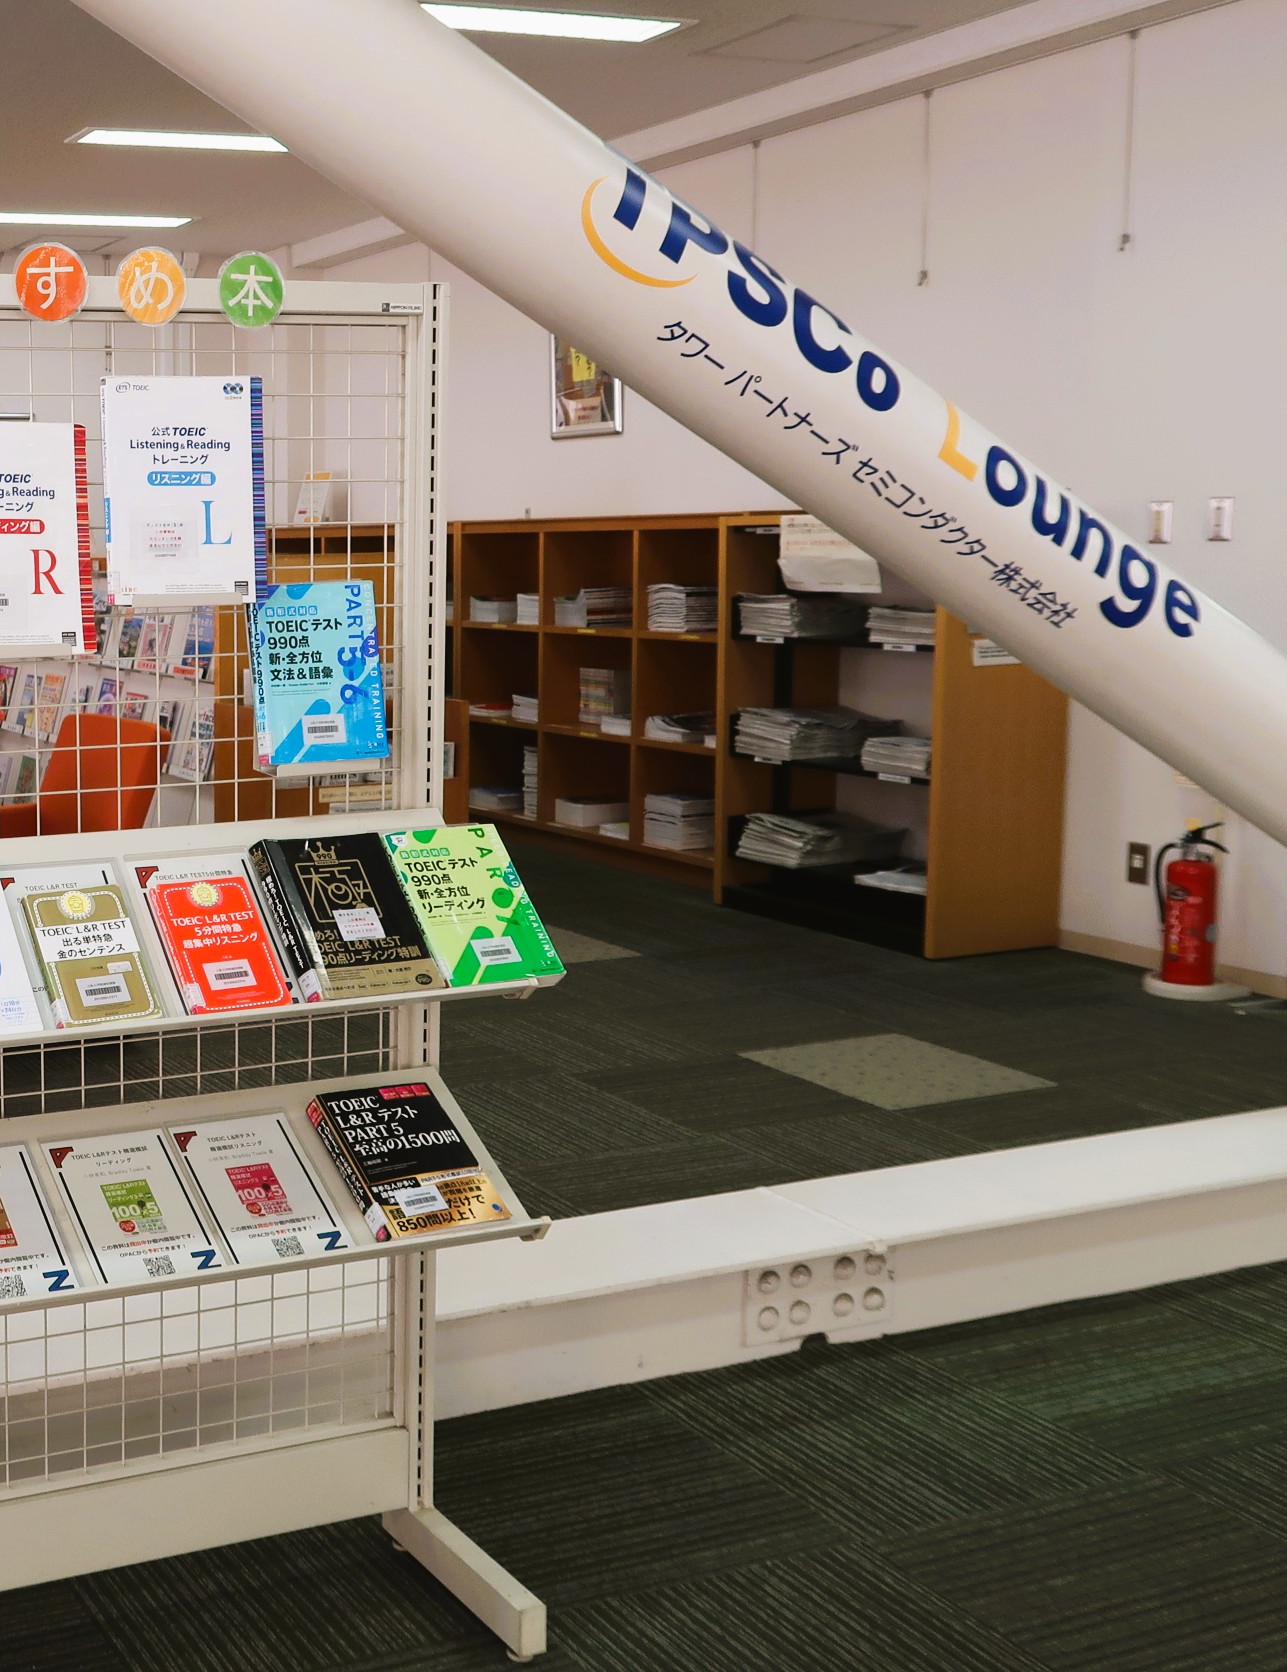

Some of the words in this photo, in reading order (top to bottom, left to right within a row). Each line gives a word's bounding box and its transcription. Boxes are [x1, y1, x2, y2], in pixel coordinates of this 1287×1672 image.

[151, 427, 170, 436] 公式
[172, 427, 206, 436] TOEIC
[130, 439, 179, 451] Listening
[187, 439, 230, 451] Reading
[153, 454, 209, 465] トレーニング
[152, 474, 211, 484] リスニング編
[657, 321, 724, 370] タワー
[724, 370, 859, 464] パートナーズ
[852, 457, 1079, 629] セミコンダクター株式会社
[12, 486, 55, 499] Reading
[200, 500, 233, 545] L
[938, 401, 1201, 637] Lounge
[29, 550, 65, 595] R
[345, 584, 365, 642] PART
[267, 620, 309, 633] TOEIC
[311, 618, 343, 631] テスト
[267, 636, 310, 650] 990点
[269, 651, 323, 665] 新・全方位
[371, 683, 384, 739] TRAINING
[405, 860, 446, 873] TOEIC
[448, 857, 478, 869] テスト
[411, 873, 453, 887] 990点
[422, 897, 486, 914] リーディング
[171, 917, 204, 927] TOEIC
[205, 915, 228, 923] L&R
[231, 910, 254, 920] TEST
[40, 928, 73, 937] TOEIC
[76, 925, 99, 934] L&R
[102, 920, 127, 930] TEST
[195, 923, 242, 936] 5分間特急
[314, 929, 339, 941] めろ!
[526, 909, 554, 957] TRAINING
[62, 933, 113, 947] 出る単特急
[183, 932, 258, 949] 超集中リスニング
[319, 941, 344, 953] OEIC
[348, 940, 371, 951] L&R
[372, 936, 401, 948] TEST
[57, 944, 125, 959] 金のセンテンス
[322, 945, 422, 965] 90点リーディング特訓
[327, 1096, 380, 1114] TOEIC
[336, 1114, 378, 1128] L&R
[378, 1105, 418, 1121] テスト
[344, 1125, 387, 1143] PART
[392, 1123, 404, 1136] 5
[354, 1129, 461, 1156] 至高の1500問
[237, 1188, 267, 1201] 100
[272, 1186, 283, 1196] 5
[112, 1205, 140, 1219] 100
[149, 1202, 159, 1214] 5
[397, 1208, 477, 1232] 850問以上!
